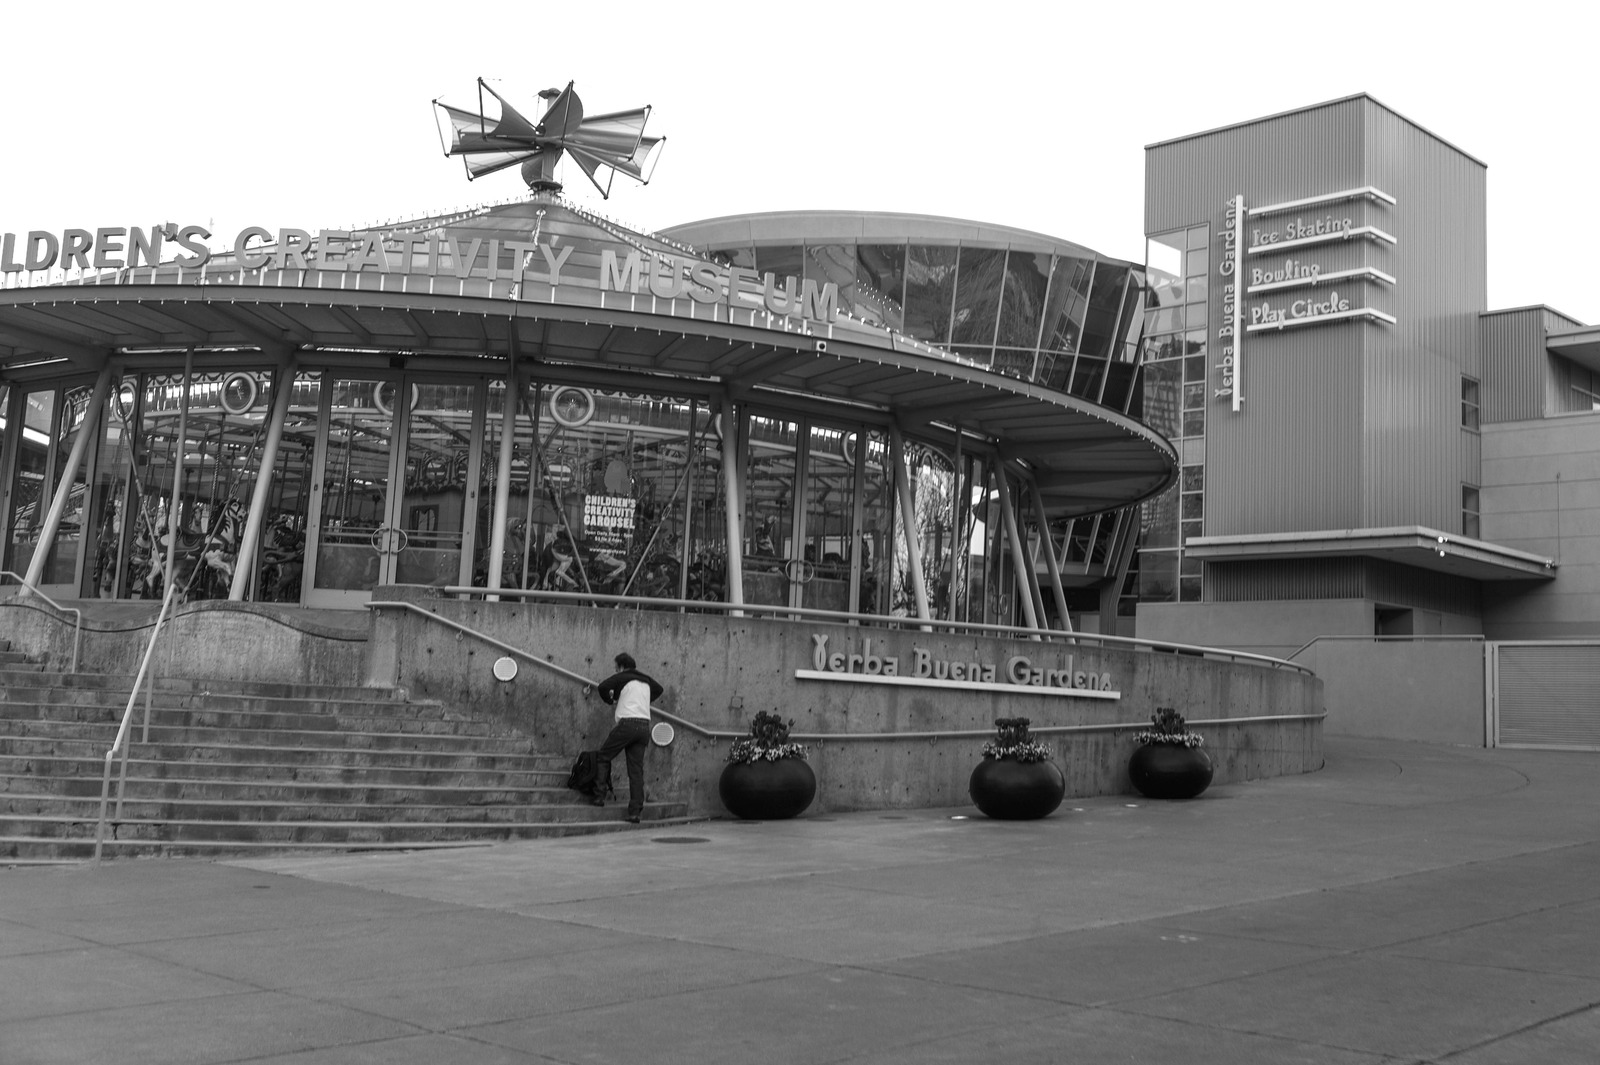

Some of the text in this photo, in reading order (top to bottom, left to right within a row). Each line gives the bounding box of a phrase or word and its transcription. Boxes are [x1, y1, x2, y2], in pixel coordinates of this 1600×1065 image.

[1253, 215, 1352, 246] Ice Skating
[0, 223, 838, 323] LDREN'S CREATIVITY MUSEUM
[1252, 259, 1320, 285] Bowling
[1214, 198, 1236, 398] Yerba Buena Gardens
[1251, 291, 1350, 330] Play Circle
[585, 495, 636, 508] CHILDREN'S
[585, 505, 635, 517] CREATIVITY
[584, 515, 635, 529] CAROUSEL
[811, 633, 1112, 692] Yerba Buena Gardens
